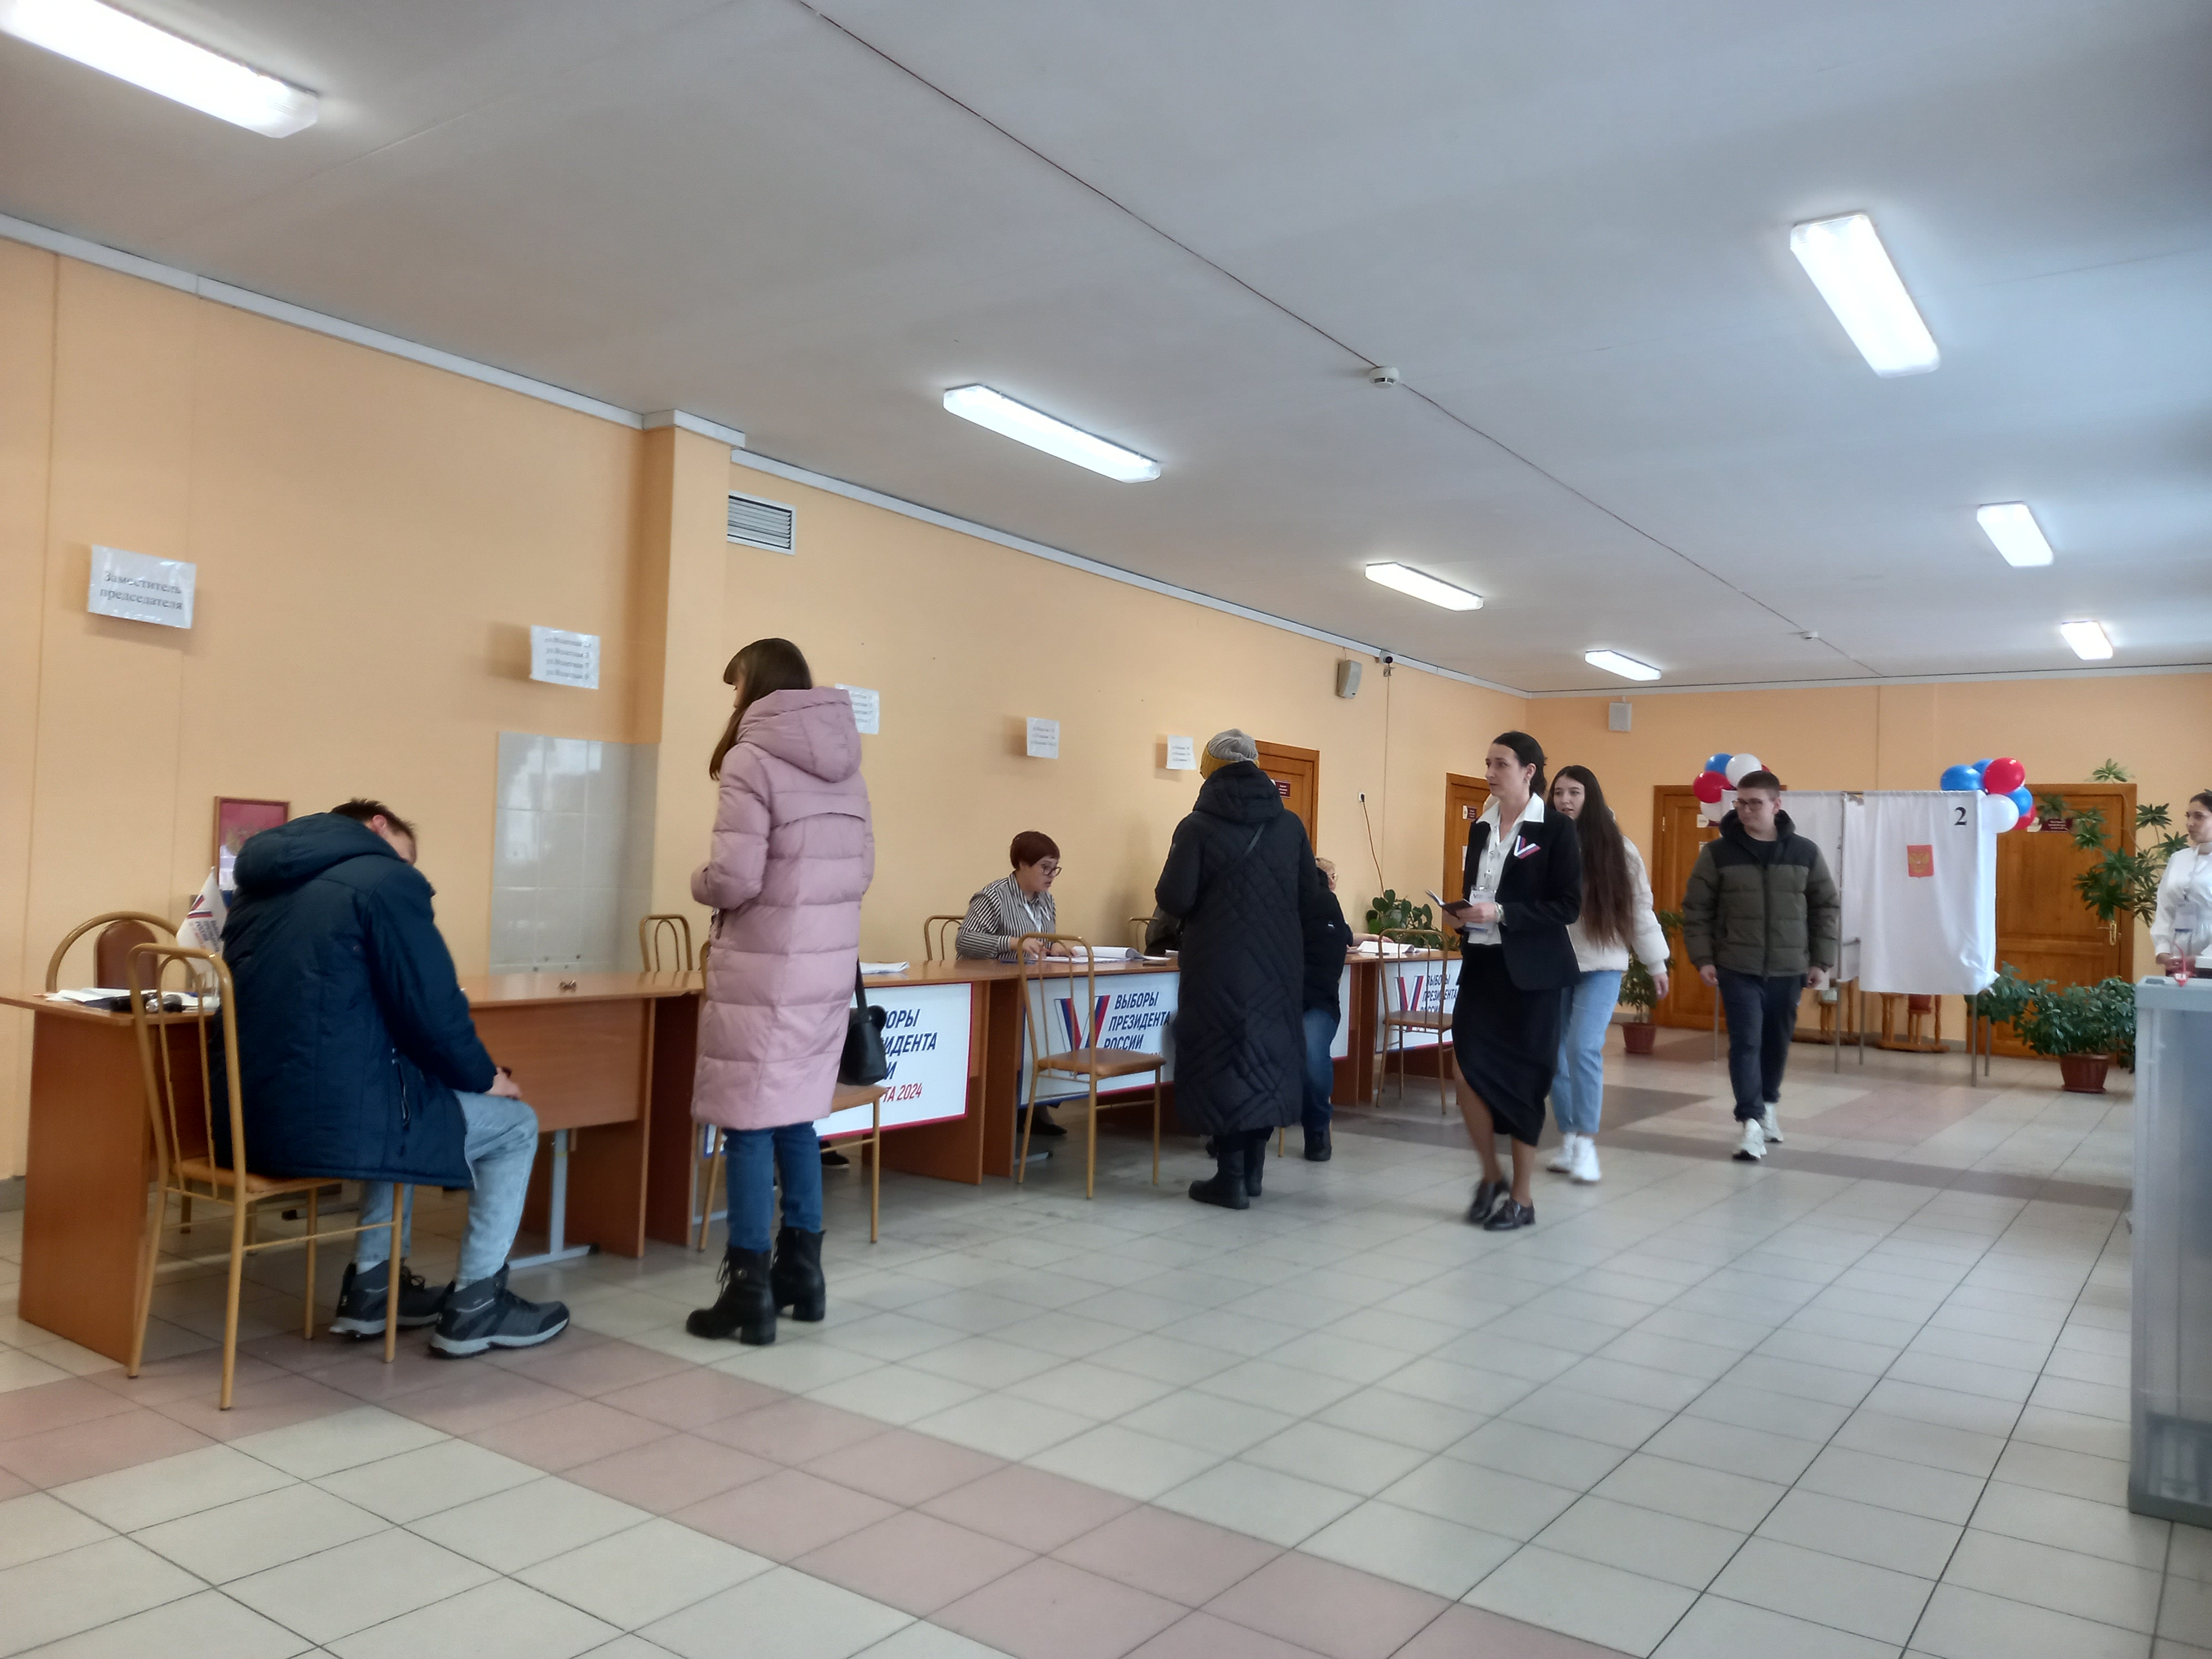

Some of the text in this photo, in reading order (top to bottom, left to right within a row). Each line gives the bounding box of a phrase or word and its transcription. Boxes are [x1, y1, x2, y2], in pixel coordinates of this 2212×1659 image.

[104, 571, 181, 594] Заместитель
[100, 588, 182, 609] председателя
[1954, 807, 1967, 826] 2
[1427, 974, 1451, 985] ВЫБОЫ
[1114, 992, 1159, 1009] ВЫБОРЫ
[1422, 989, 1457, 1002] ПРЕЗИЕНТА
[885, 1009, 921, 1029] ОРЫ
[1108, 1011, 1170, 1031] ПРЕЗИДЕНТА
[884, 1032, 938, 1057] ИДЕНТА
[1103, 1034, 1144, 1050] РОССИИ
[896, 1082, 922, 1100] 2024
